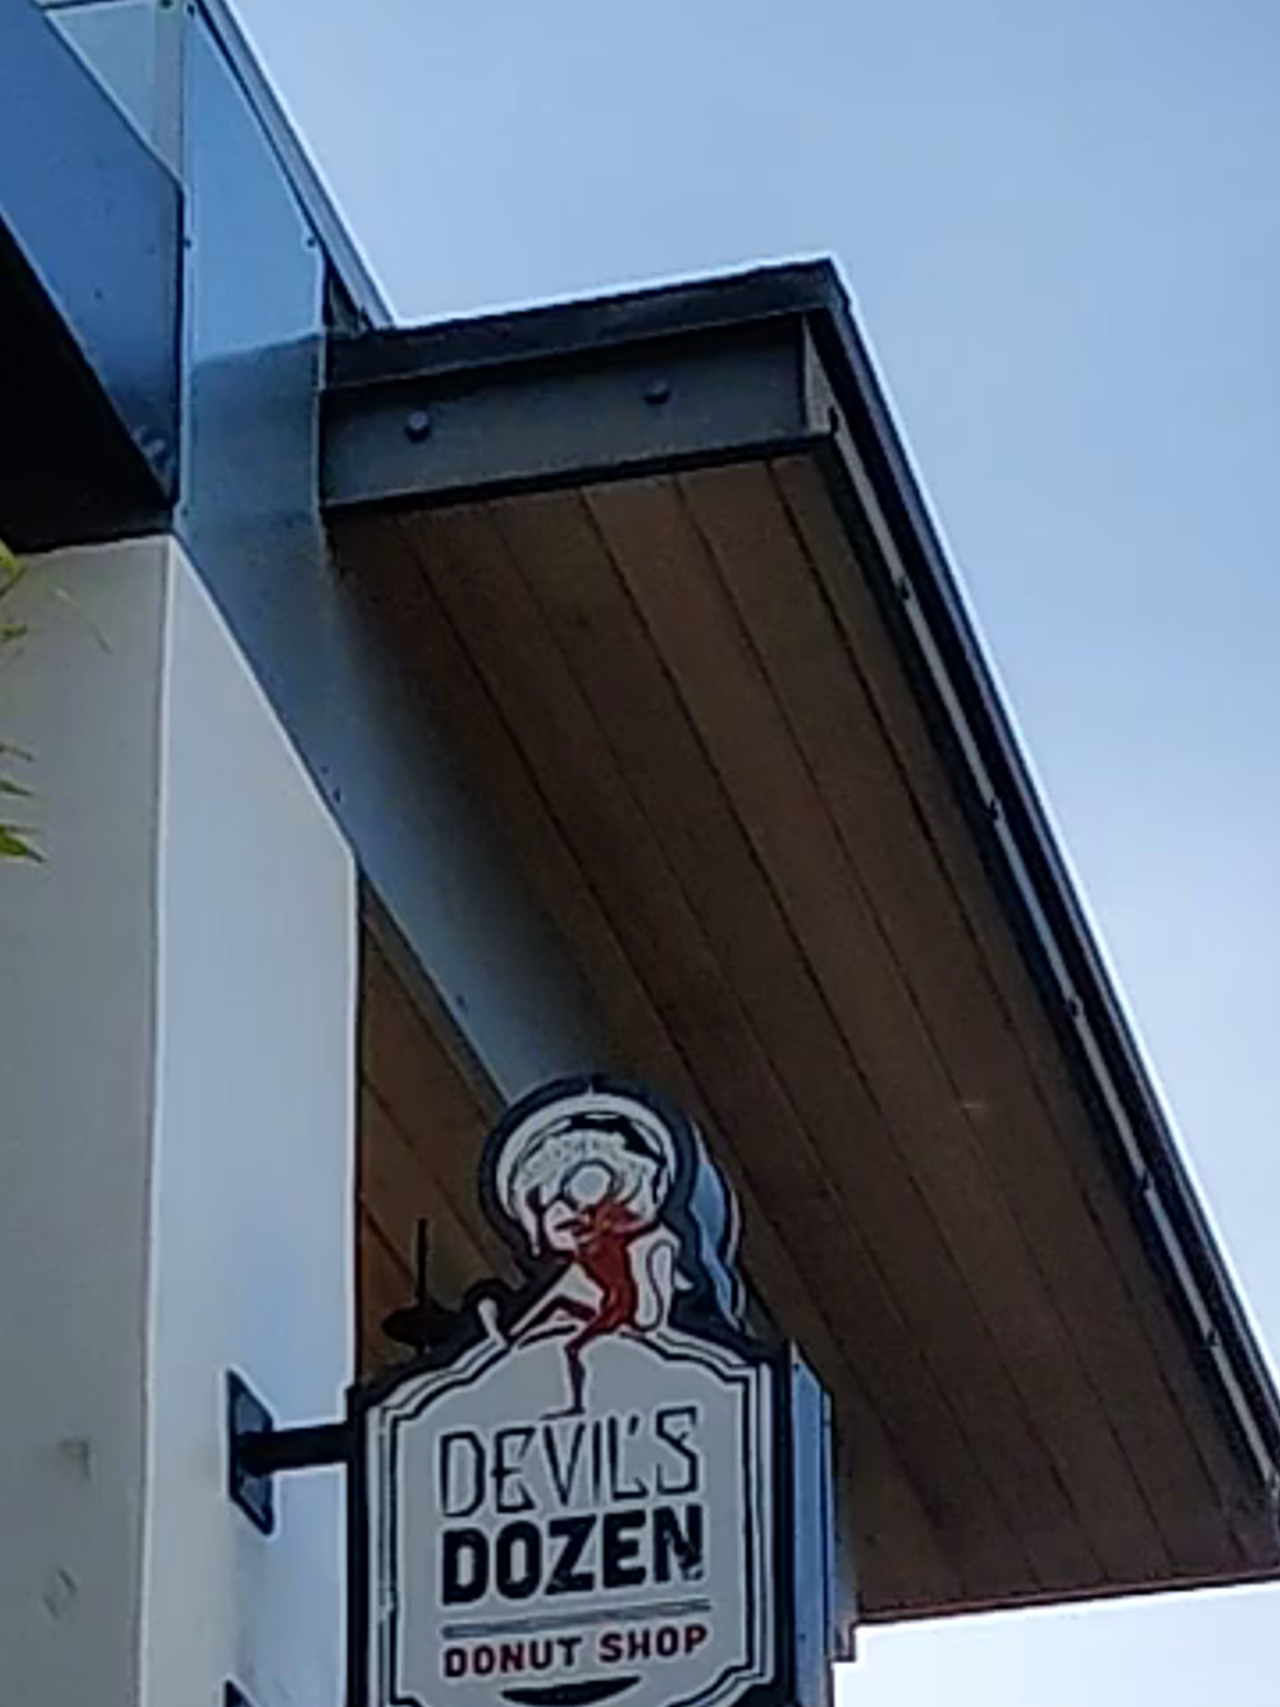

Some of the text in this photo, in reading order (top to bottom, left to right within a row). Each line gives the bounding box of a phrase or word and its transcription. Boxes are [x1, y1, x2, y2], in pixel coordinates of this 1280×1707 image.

[439, 1405, 700, 1517] DEVIL'S
[441, 1504, 704, 1606] DOZEN
[443, 1623, 708, 1679] DONUT SHOP
